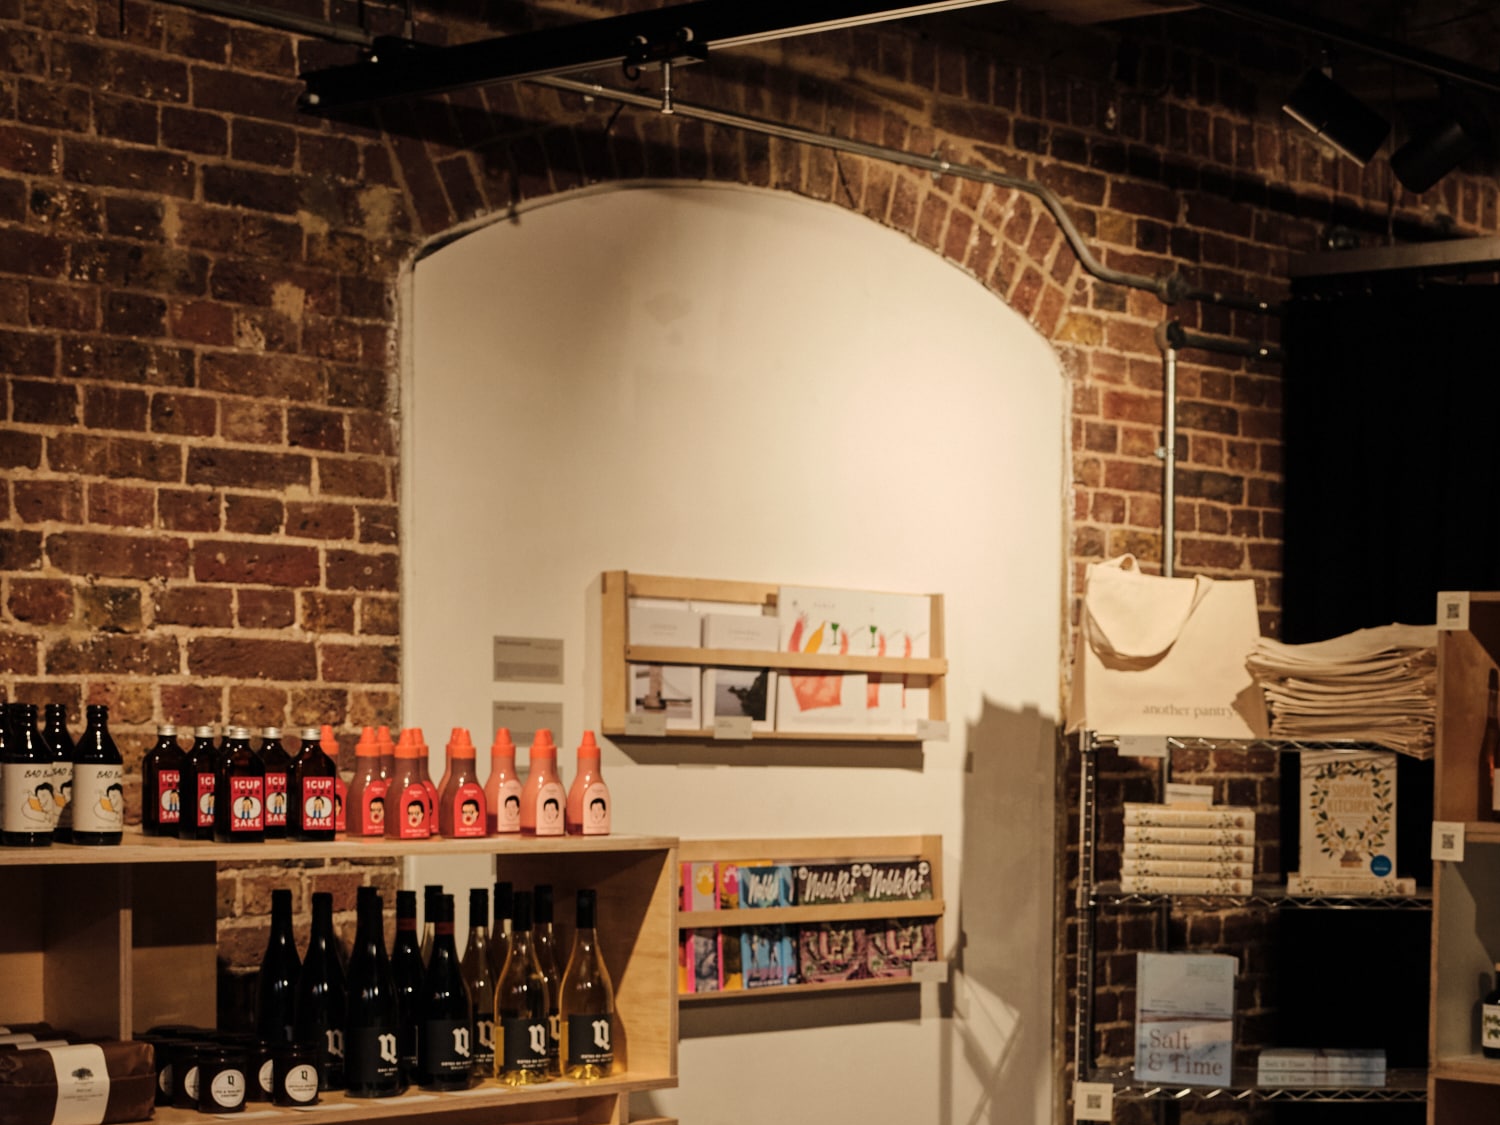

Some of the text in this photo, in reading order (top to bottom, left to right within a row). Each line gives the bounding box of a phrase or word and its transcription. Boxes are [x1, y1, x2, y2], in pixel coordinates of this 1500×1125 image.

[1143, 704, 1191, 717] another
[234, 780, 261, 789] 1CUP
[305, 780, 332, 789] 1CUP
[234, 818, 261, 827] SAKE
[305, 818, 331, 827] SAKE
[1149, 1028, 1191, 1050] Salt
[1148, 1052, 1223, 1076] & Time
